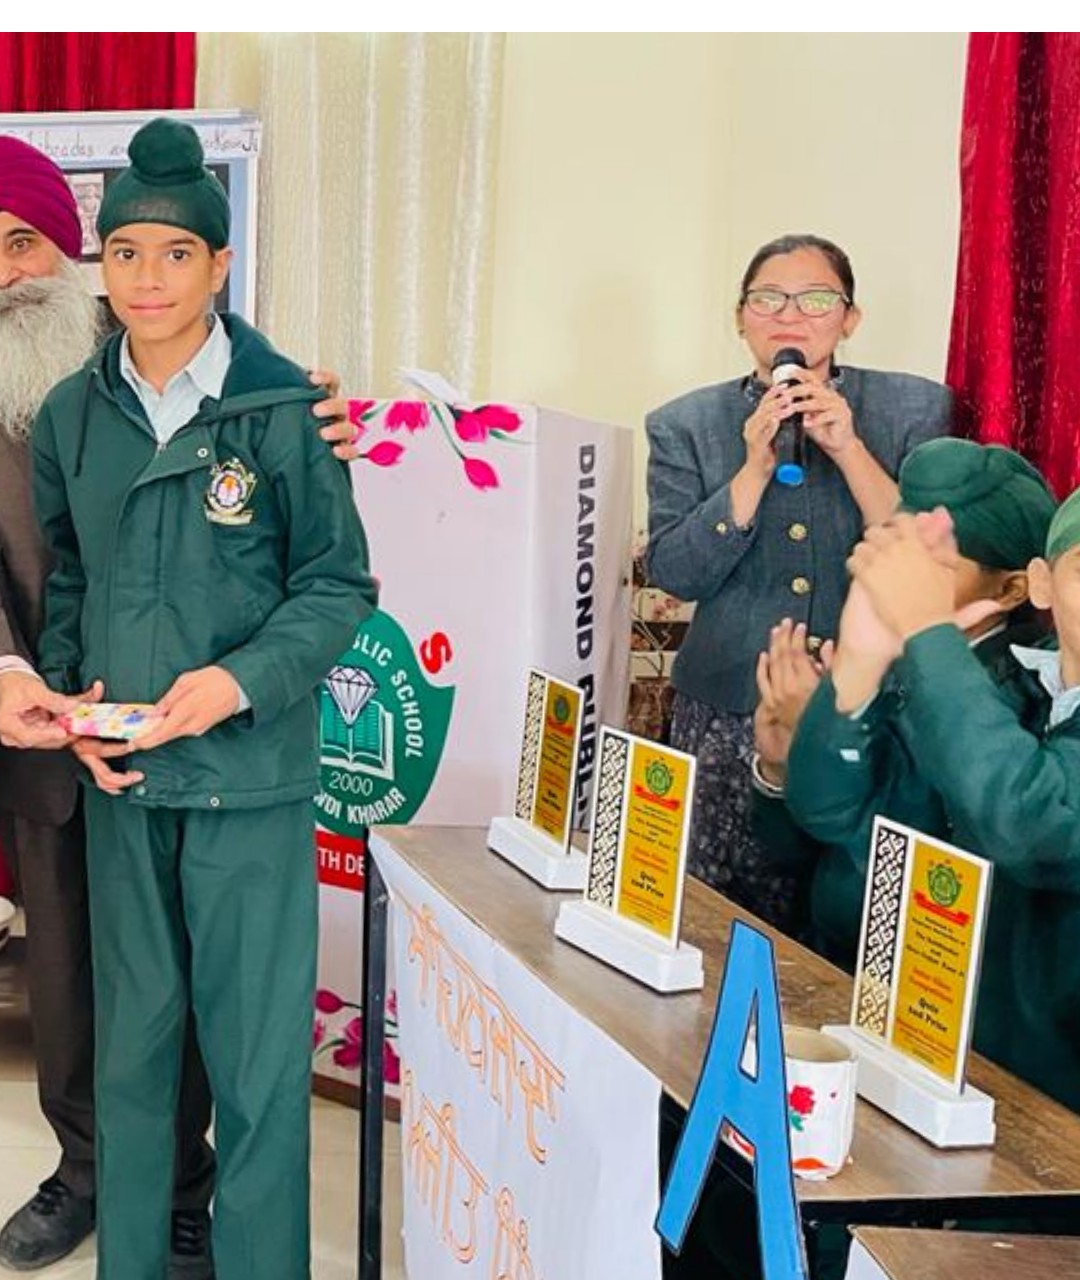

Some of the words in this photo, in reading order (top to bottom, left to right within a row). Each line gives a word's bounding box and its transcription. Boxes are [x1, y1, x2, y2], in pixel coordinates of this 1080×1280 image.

[576, 444, 595, 661] DIAMOND
[390, 668, 425, 758] SCHOOL
[328, 769, 374, 797] 2000
[346, 785, 407, 827] KHARAR
[654, 918, 809, 1280] A
